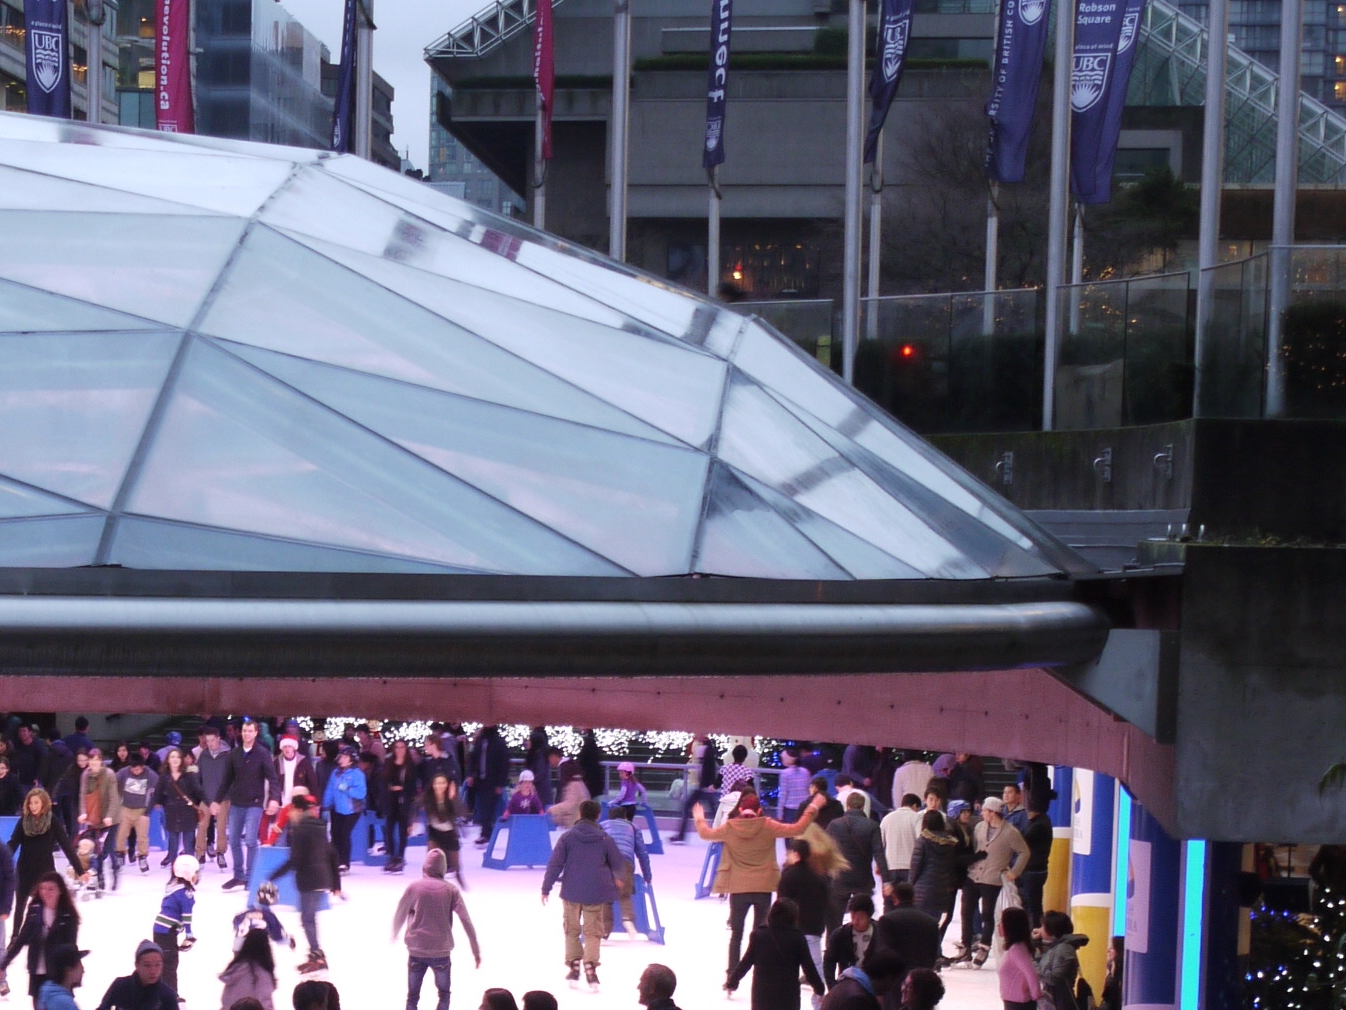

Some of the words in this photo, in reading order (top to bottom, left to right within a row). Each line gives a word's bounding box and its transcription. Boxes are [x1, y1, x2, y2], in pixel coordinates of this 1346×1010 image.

[1078, 2, 1116, 13] Robson
[1076, 14, 1112, 25] Square
[35, 34, 59, 51] UBC
[1002, 20, 1014, 65] BRITISH
[1073, 56, 1106, 71] UBC
[999, 68, 1008, 83] OF
